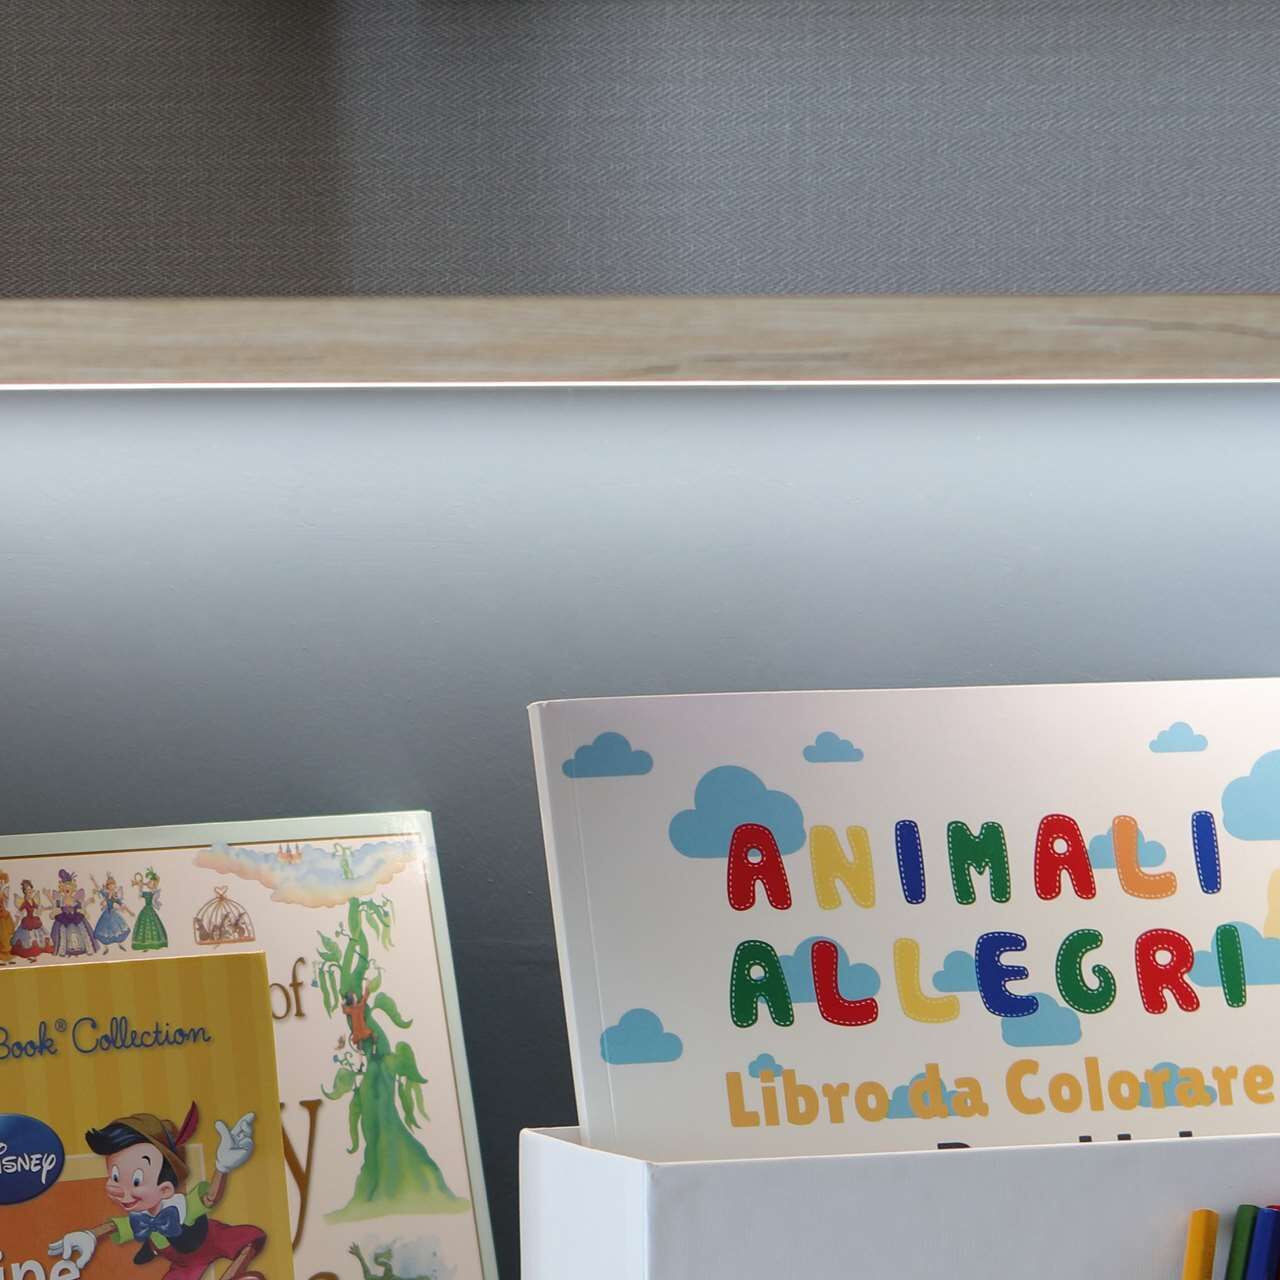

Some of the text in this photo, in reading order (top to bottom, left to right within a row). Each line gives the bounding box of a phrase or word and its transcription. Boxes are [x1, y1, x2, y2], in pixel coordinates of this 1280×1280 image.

[726, 809, 1222, 912] ANIMALI
[269, 957, 306, 1020] of
[729, 923, 1249, 1029] ALLEGRI
[71, 1015, 212, 1055] Collection
[725, 1056, 1276, 1128] Libro da Colorare
